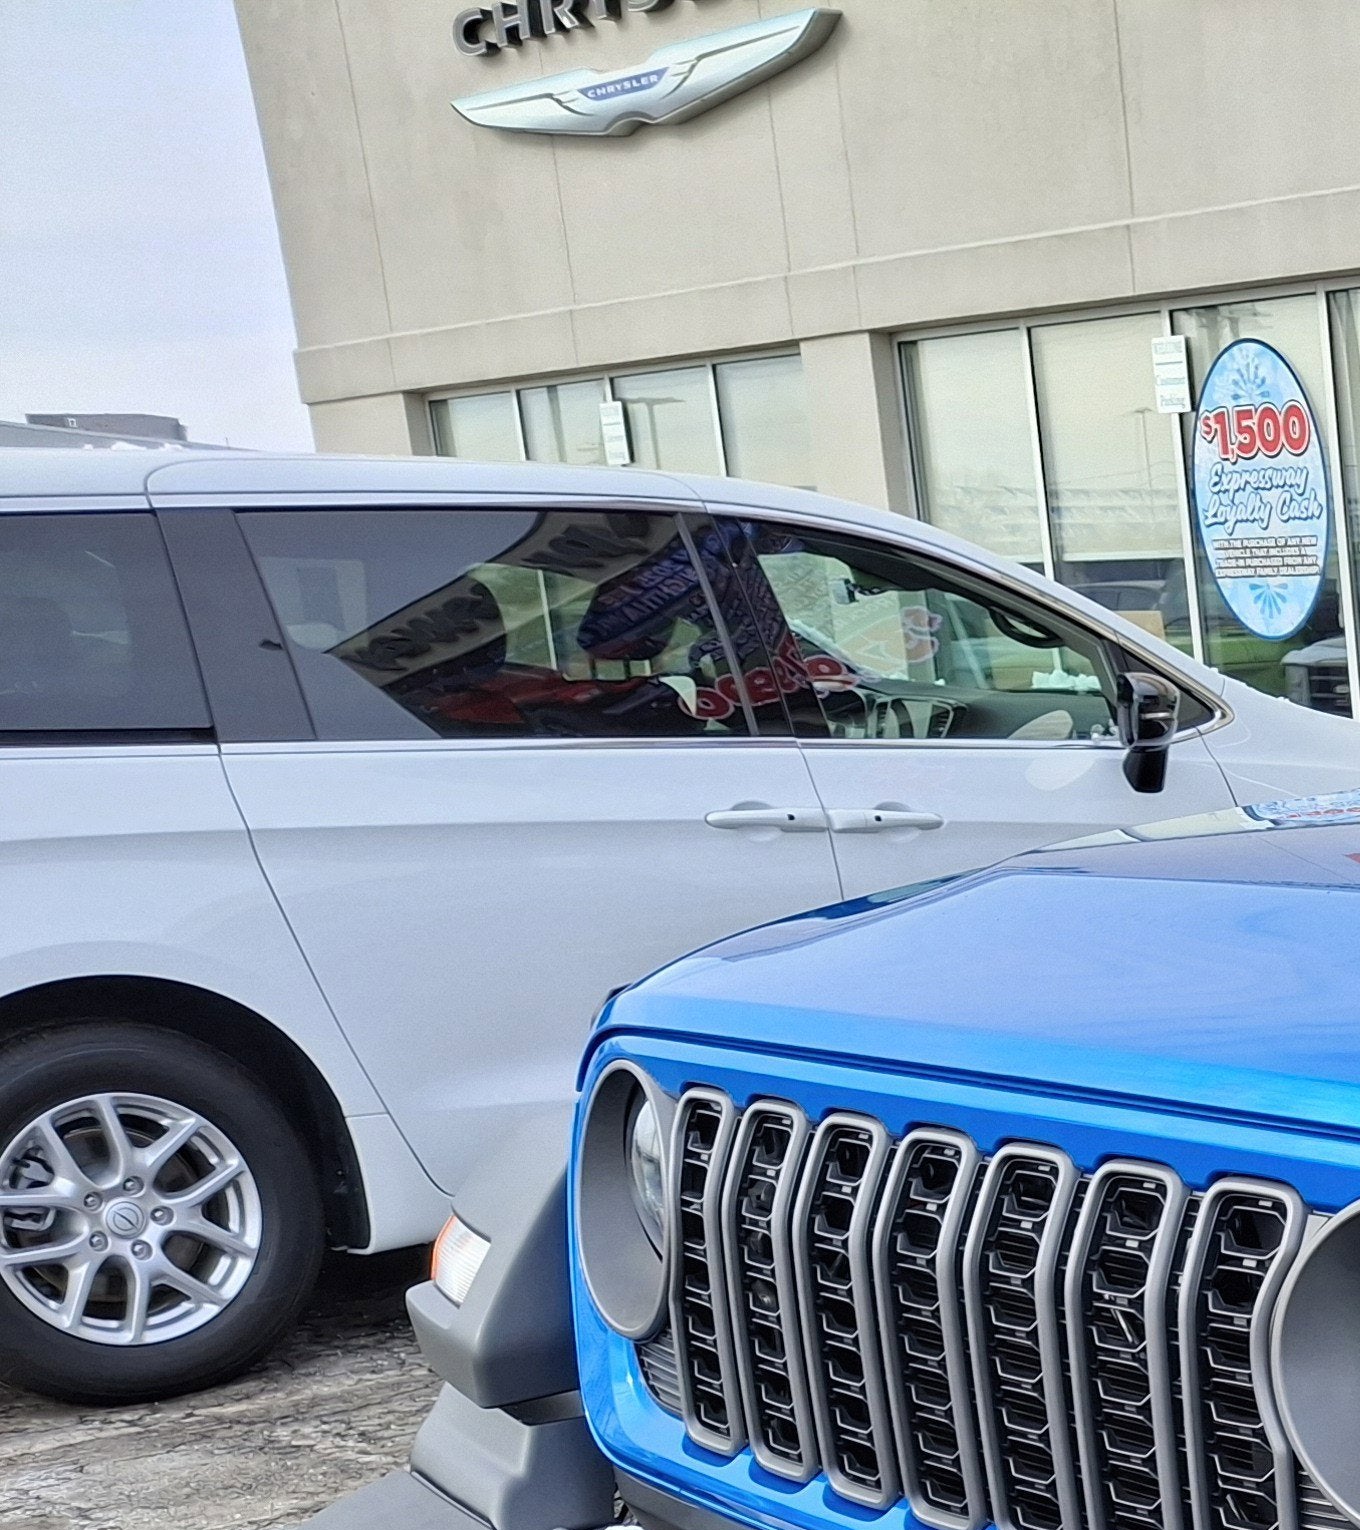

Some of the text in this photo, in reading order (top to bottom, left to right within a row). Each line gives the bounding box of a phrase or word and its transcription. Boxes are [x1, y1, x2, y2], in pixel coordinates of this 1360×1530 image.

[586, 73, 661, 99] CHRYSLER
[1200, 400, 1310, 464] $1,500
[1209, 462, 1309, 504] Expressway
[1203, 488, 1323, 536] Loyalty Cash
